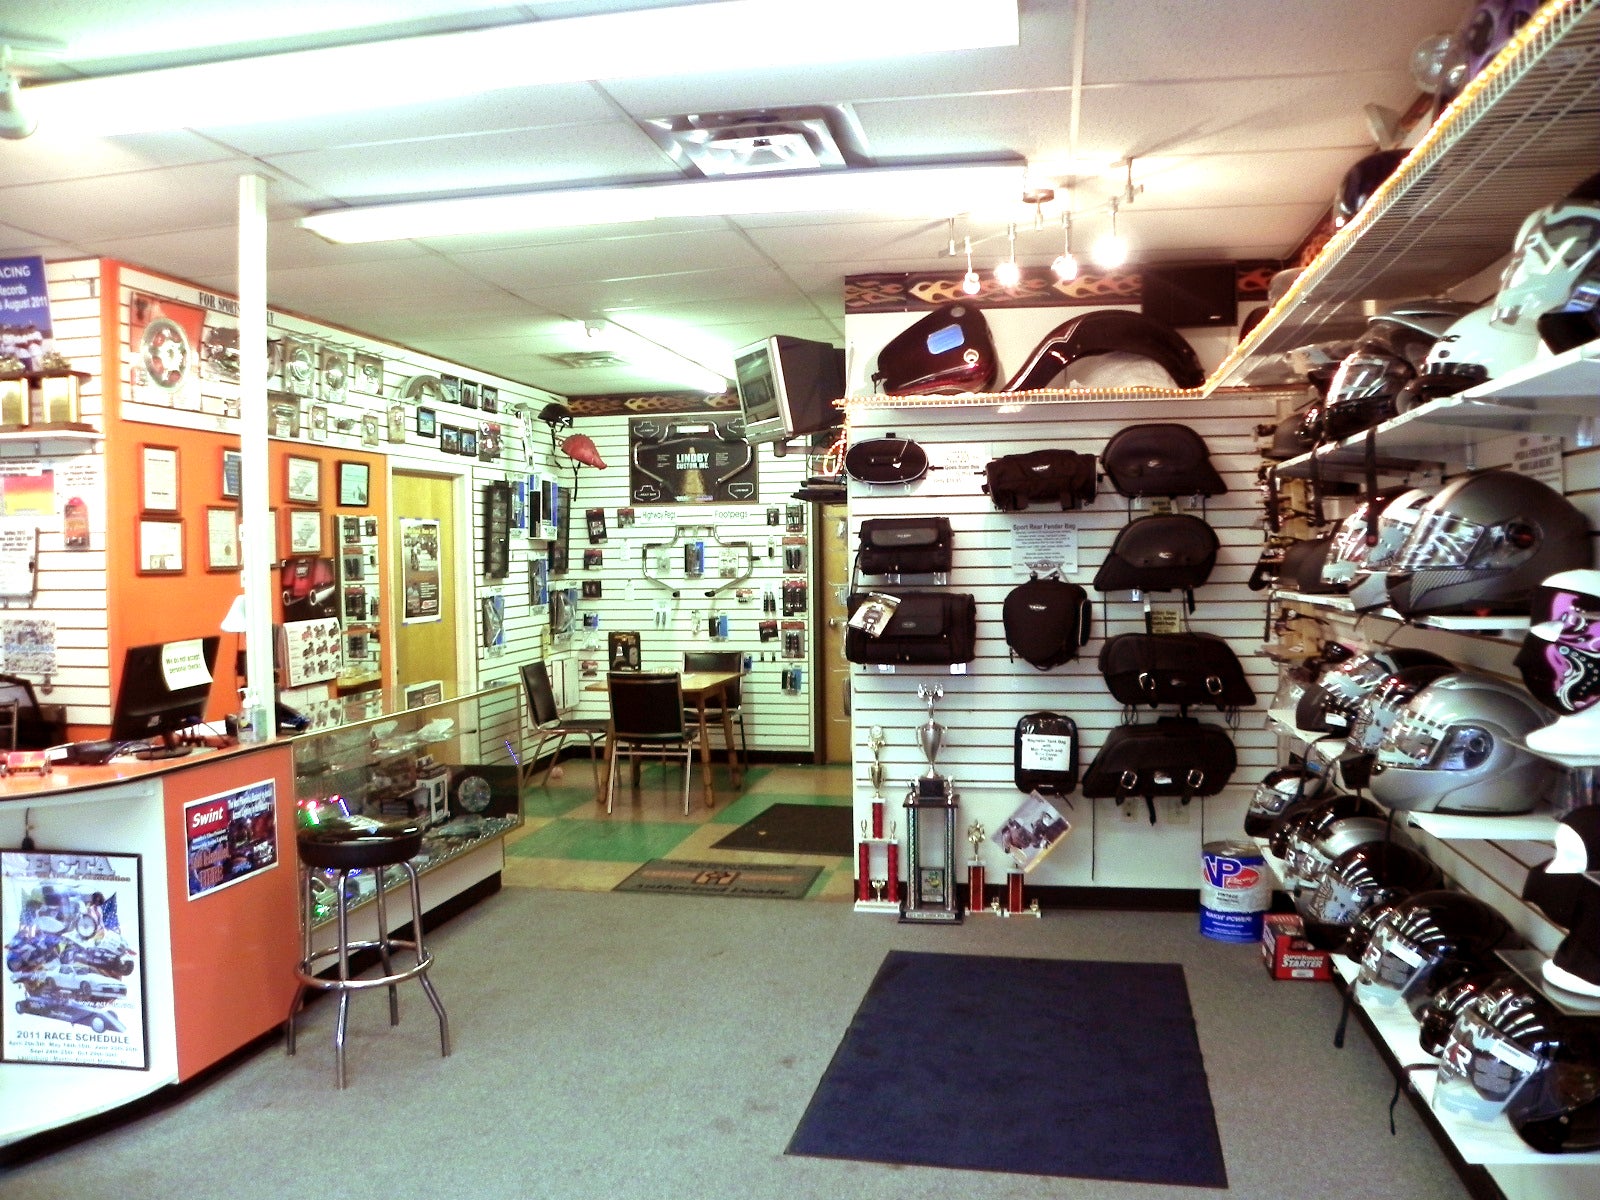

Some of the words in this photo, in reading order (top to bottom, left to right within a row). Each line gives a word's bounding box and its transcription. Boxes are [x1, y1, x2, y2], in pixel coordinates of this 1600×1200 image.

[676, 453, 710, 463] LINDBY
[192, 806, 224, 828] Swint
[1203, 855, 1242, 889] VP
[16, 1030, 40, 1039] 2011
[44, 1032, 73, 1041] RACE
[75, 1034, 130, 1045] SCHEDULE
